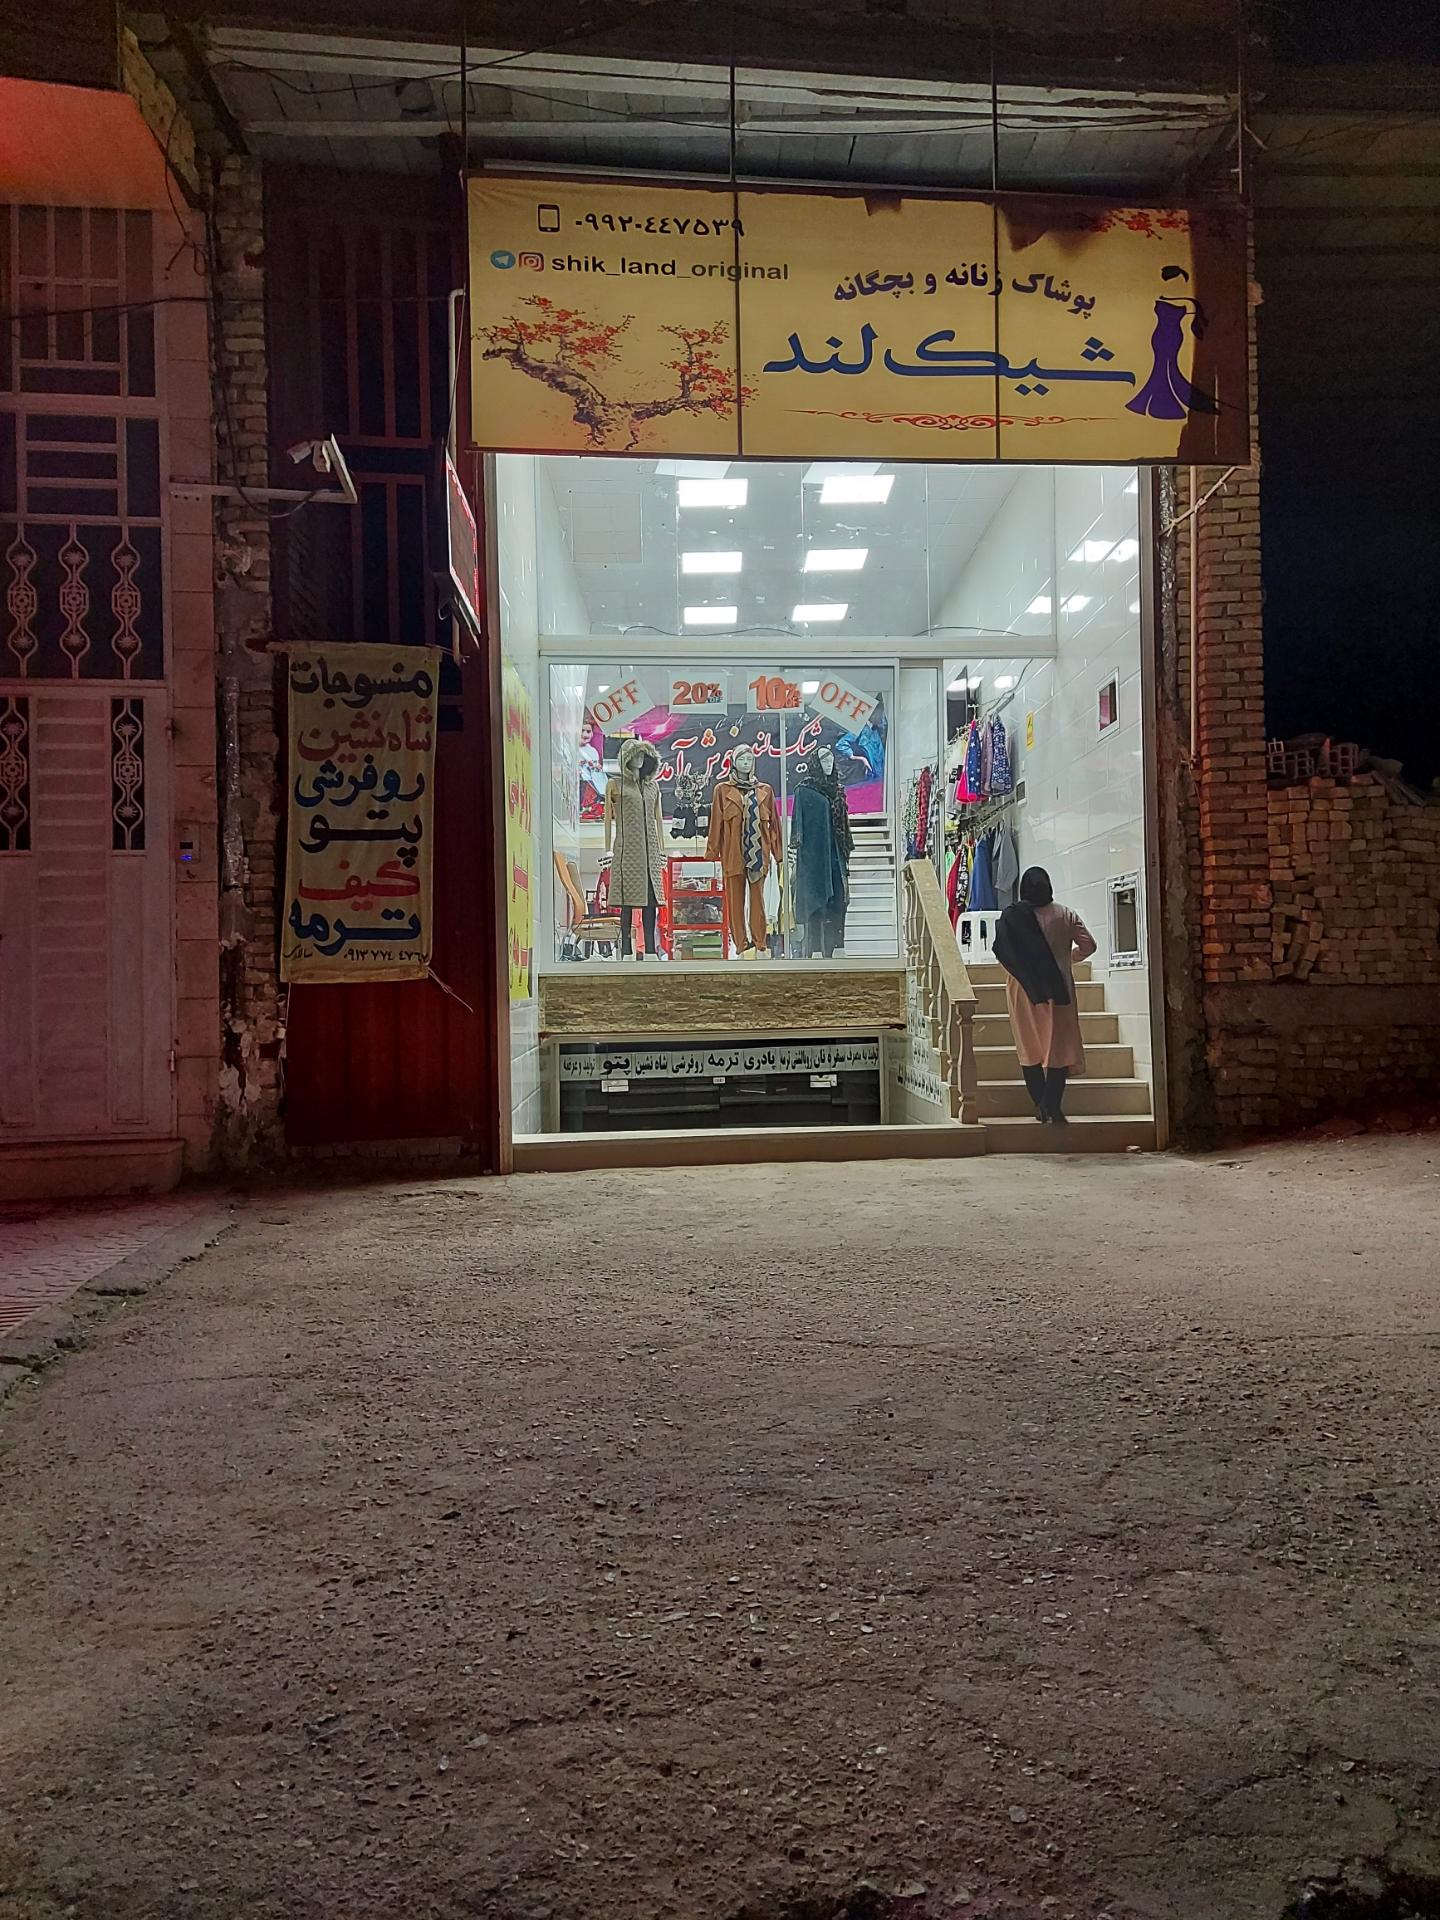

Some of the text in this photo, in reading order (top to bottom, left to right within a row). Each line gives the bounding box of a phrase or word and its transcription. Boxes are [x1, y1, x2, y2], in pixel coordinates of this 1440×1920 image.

[551, 253, 789, 282] shik_land_original
[833, 262, 1096, 320] پوشاک زنانه و بچگانه
[762, 322, 1137, 397] شیک لند
[289, 656, 434, 709] منسوجات
[592, 679, 640, 723] OFF
[672, 680, 723, 705] 20%
[749, 675, 800, 710] 10%
[820, 681, 873, 722] OFF
[297, 706, 432, 762] شاه نشین
[294, 754, 425, 808] روفرشی
[299, 808, 423, 868] پتو
[299, 860, 421, 912] کیف
[600, 1055, 632, 1076] پتو
[635, 1055, 653, 1075] نشین
[655, 1053, 669, 1071] شاه
[672, 1053, 704, 1074] روفرشی
[708, 1051, 739, 1072] ترمه
[744, 1050, 776, 1070] پادری
